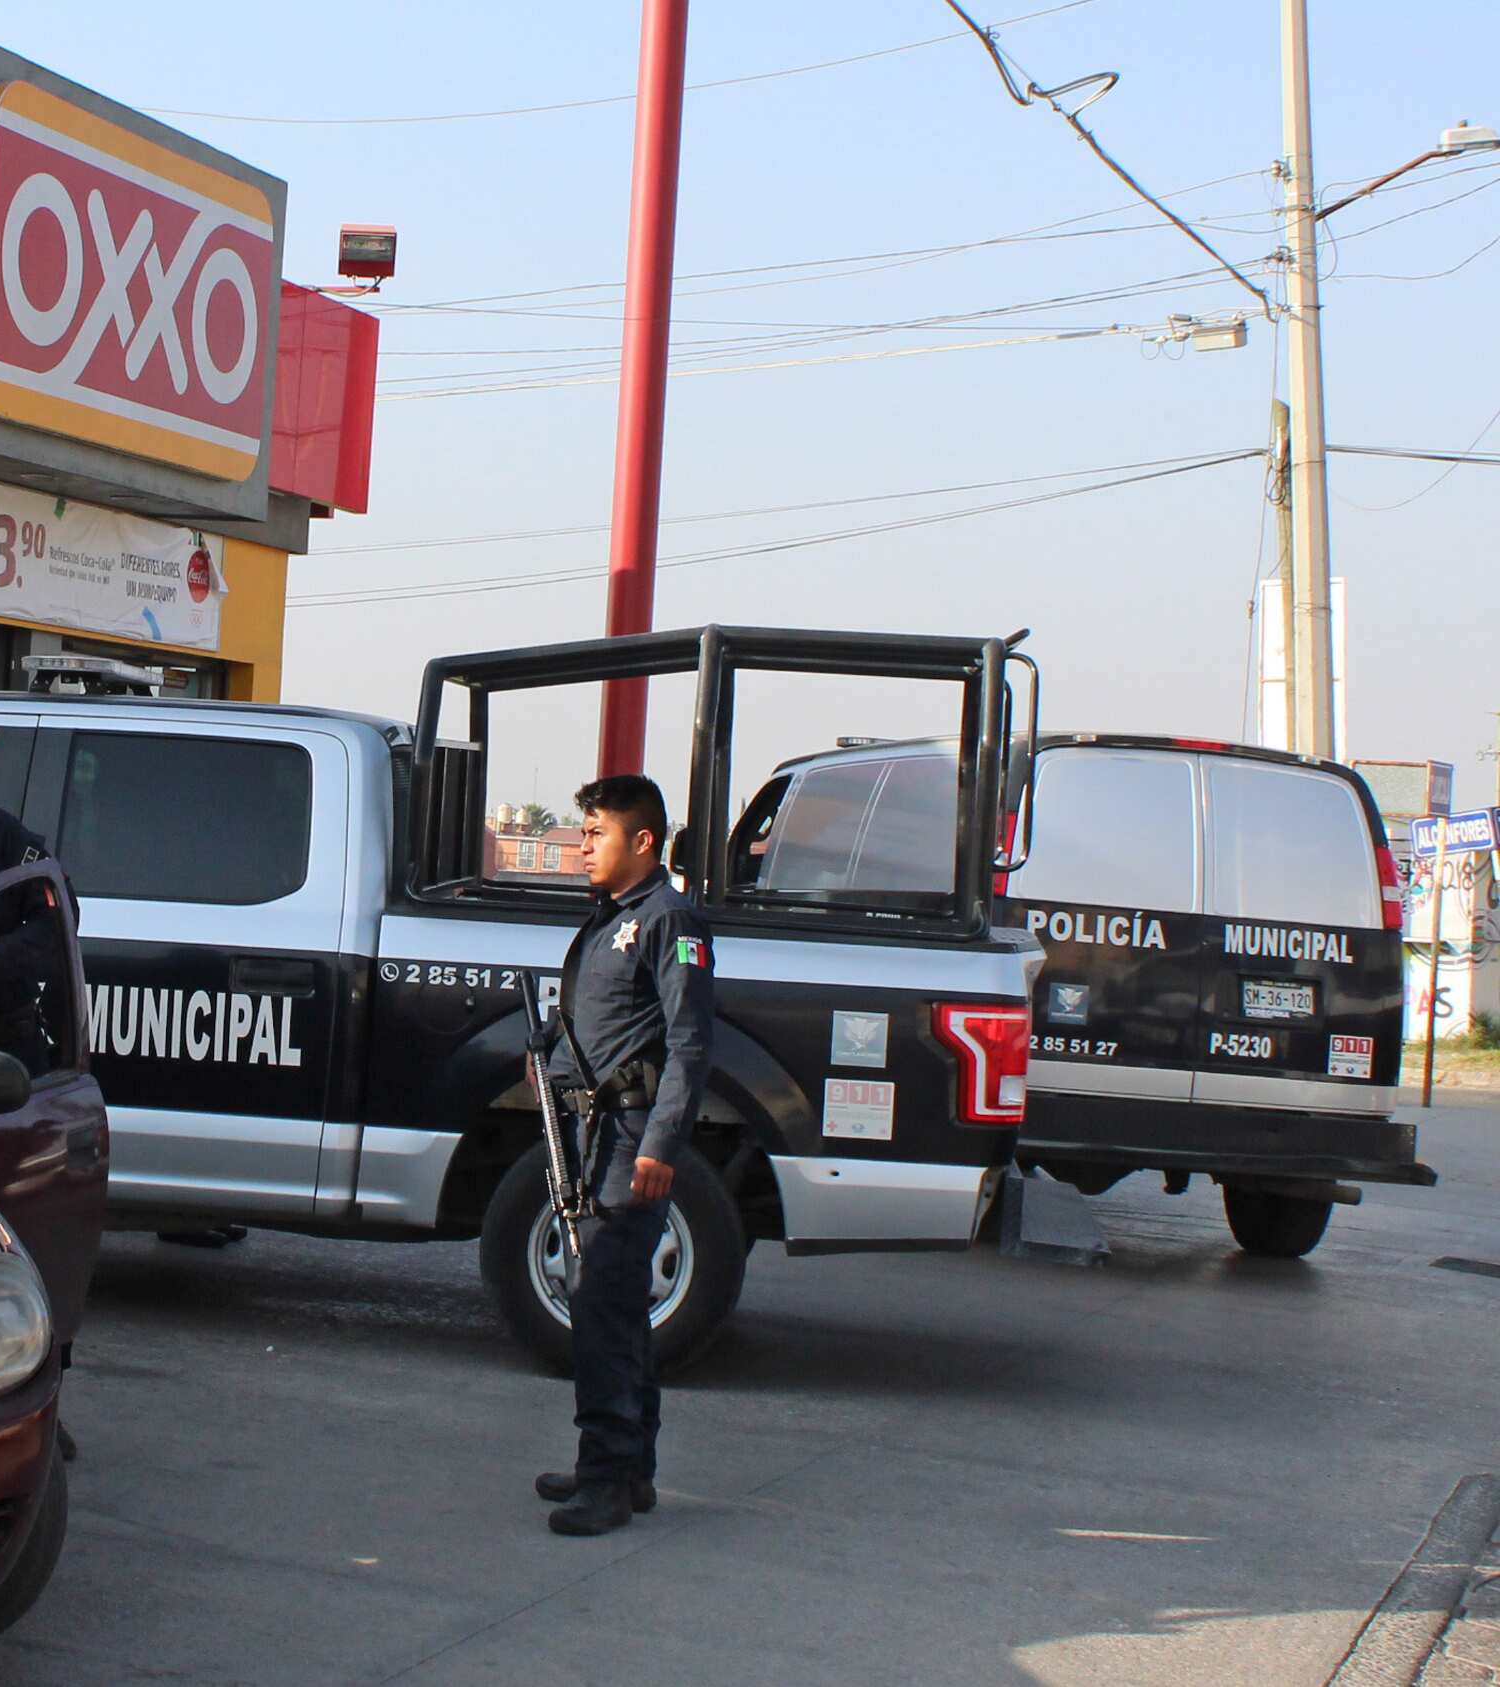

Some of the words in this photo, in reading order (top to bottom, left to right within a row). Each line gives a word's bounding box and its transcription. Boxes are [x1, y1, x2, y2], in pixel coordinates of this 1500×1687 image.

[2, 173, 257, 404] OXXO
[1418, 818, 1489, 849] ALCNFORES
[1026, 910, 1166, 950] POLICÍA
[1224, 923, 1354, 964] MUNICIPAL
[405, 964, 421, 983] 2
[428, 966, 457, 986] 85
[465, 968, 492, 988] 51
[84, 984, 301, 1067] MUNICIPAL
[1030, 1035, 1039, 1049] 2
[1043, 1036, 1065, 1052] 85
[1070, 1038, 1090, 1054] 51
[1095, 1041, 1118, 1056] 27
[1210, 1032, 1272, 1059] P-5230
